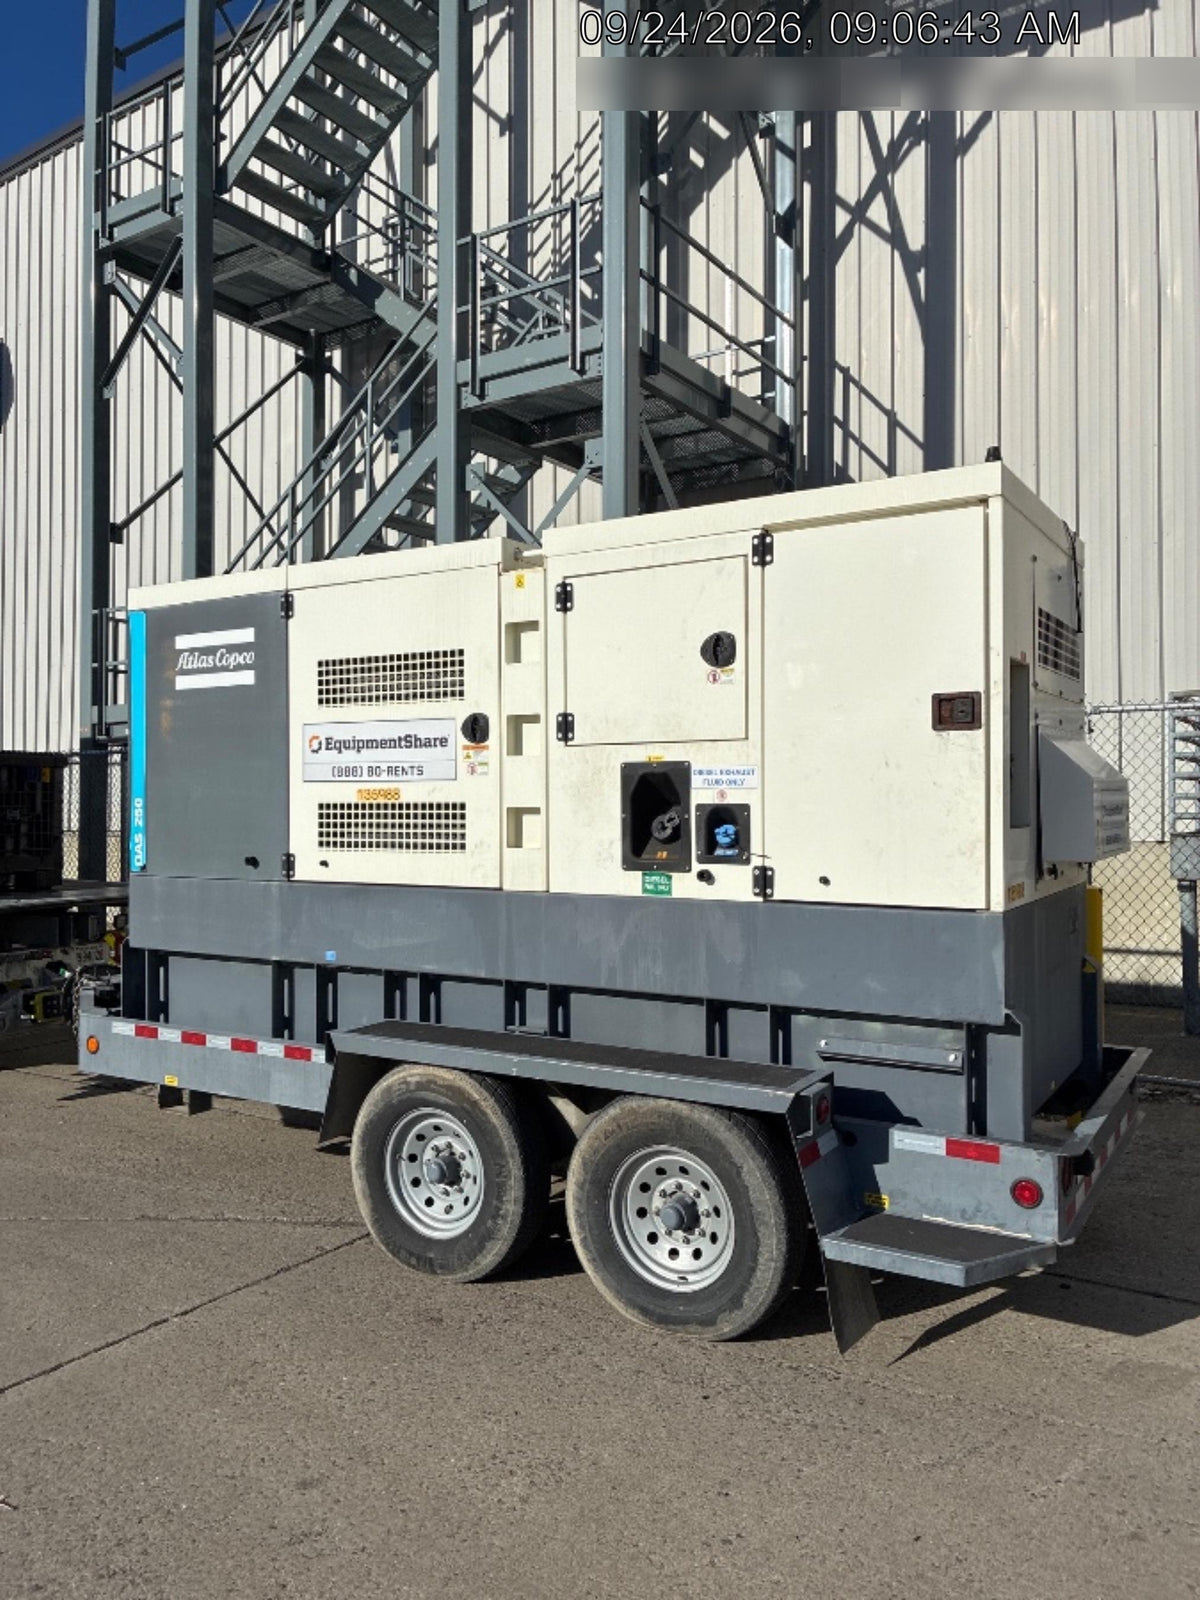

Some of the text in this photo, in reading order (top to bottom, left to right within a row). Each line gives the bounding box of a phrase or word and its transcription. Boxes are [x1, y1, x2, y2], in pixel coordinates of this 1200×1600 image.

[175, 648, 255, 671] Atlas Copco
[324, 734, 449, 754] EquipmentShare
